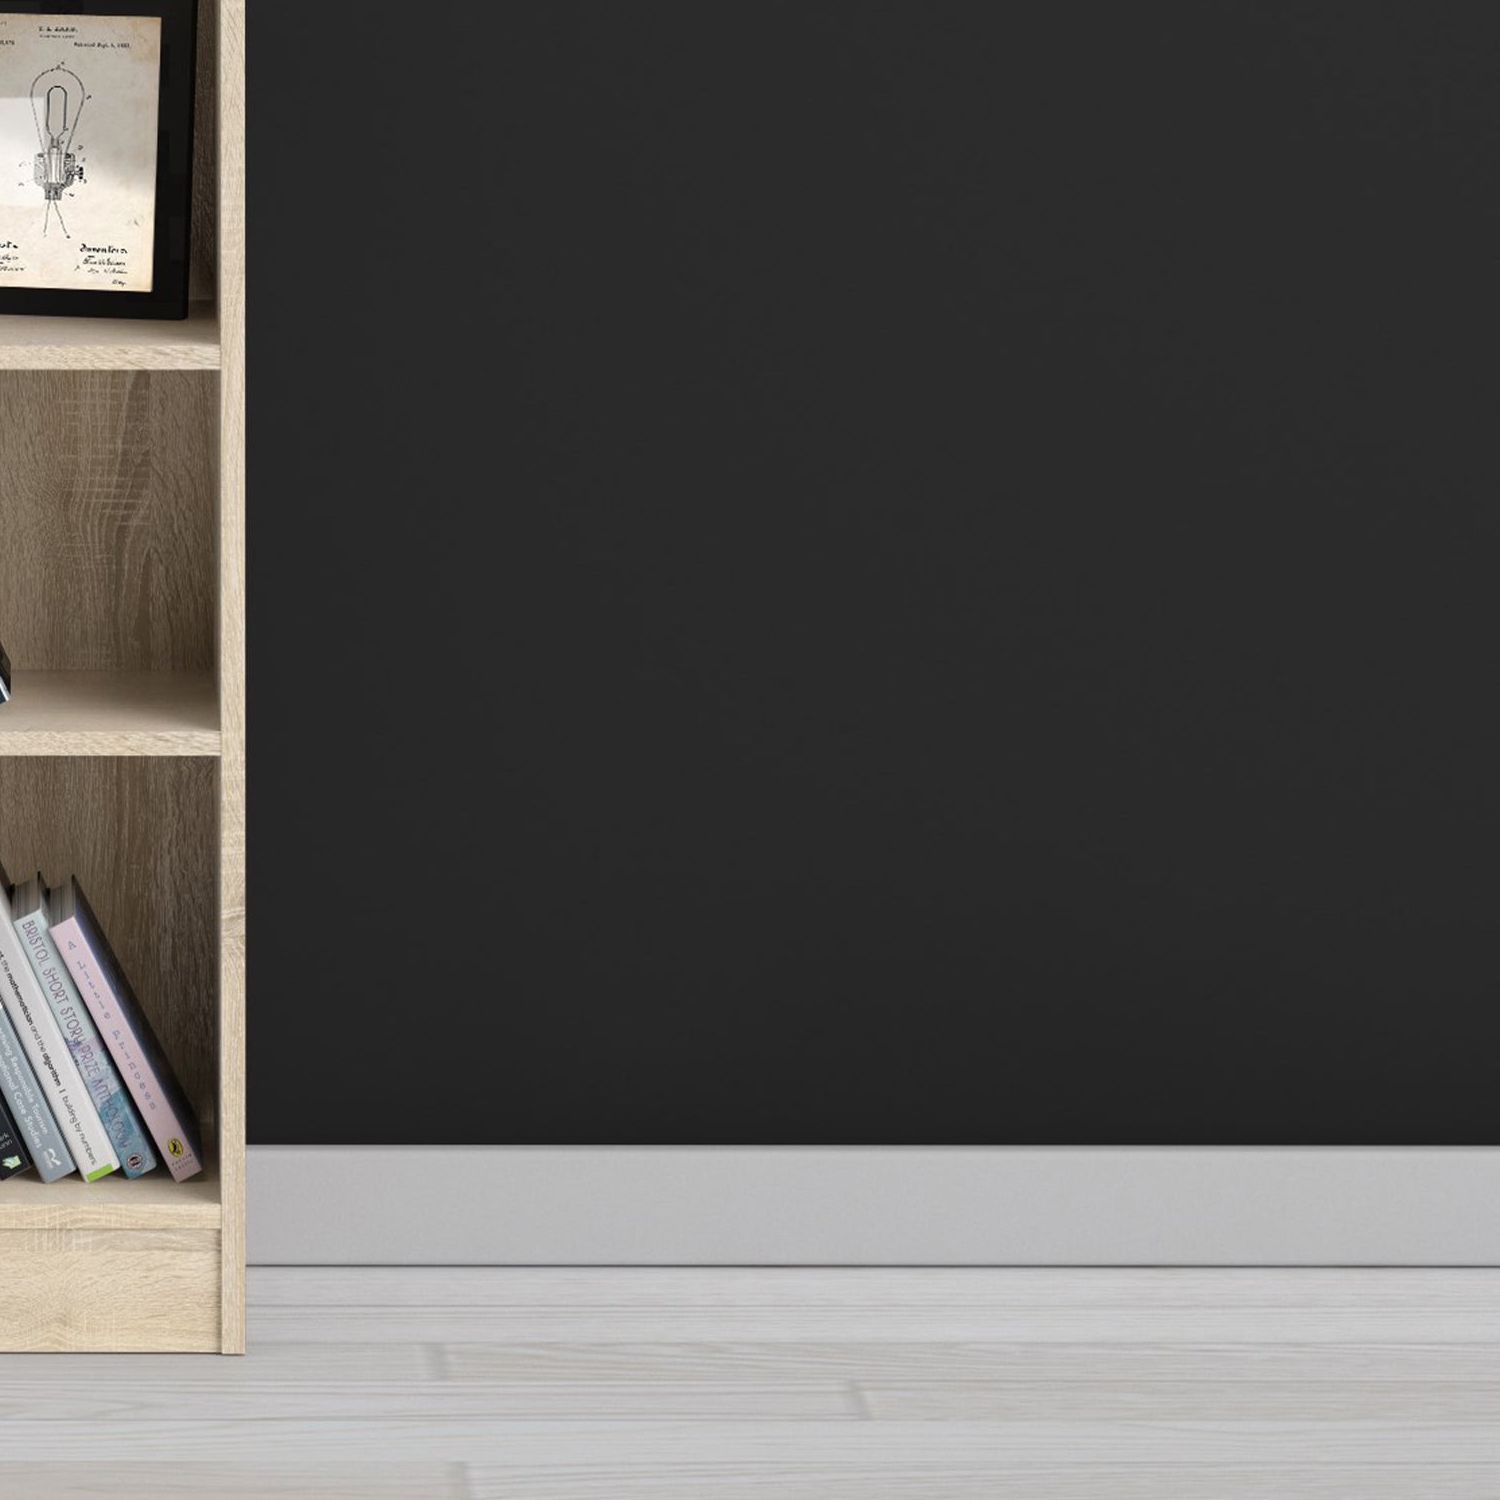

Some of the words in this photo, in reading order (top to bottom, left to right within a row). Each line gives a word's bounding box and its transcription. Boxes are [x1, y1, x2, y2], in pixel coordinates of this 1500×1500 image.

[0, 959, 11, 972] the
[5, 971, 34, 1025] mathematician
[21, 919, 52, 967] BRISTOL
[41, 965, 69, 1006] SHORT
[76, 1043, 101, 1076] PRIZE
[29, 1024, 41, 1040] and
[36, 1039, 47, 1053] the
[40, 1051, 62, 1087] algorithm
[12, 1090, 29, 1115] Case
[22, 1115, 44, 1149] Studies
[59, 1095, 79, 1124] building
[72, 1121, 83, 1133] by
